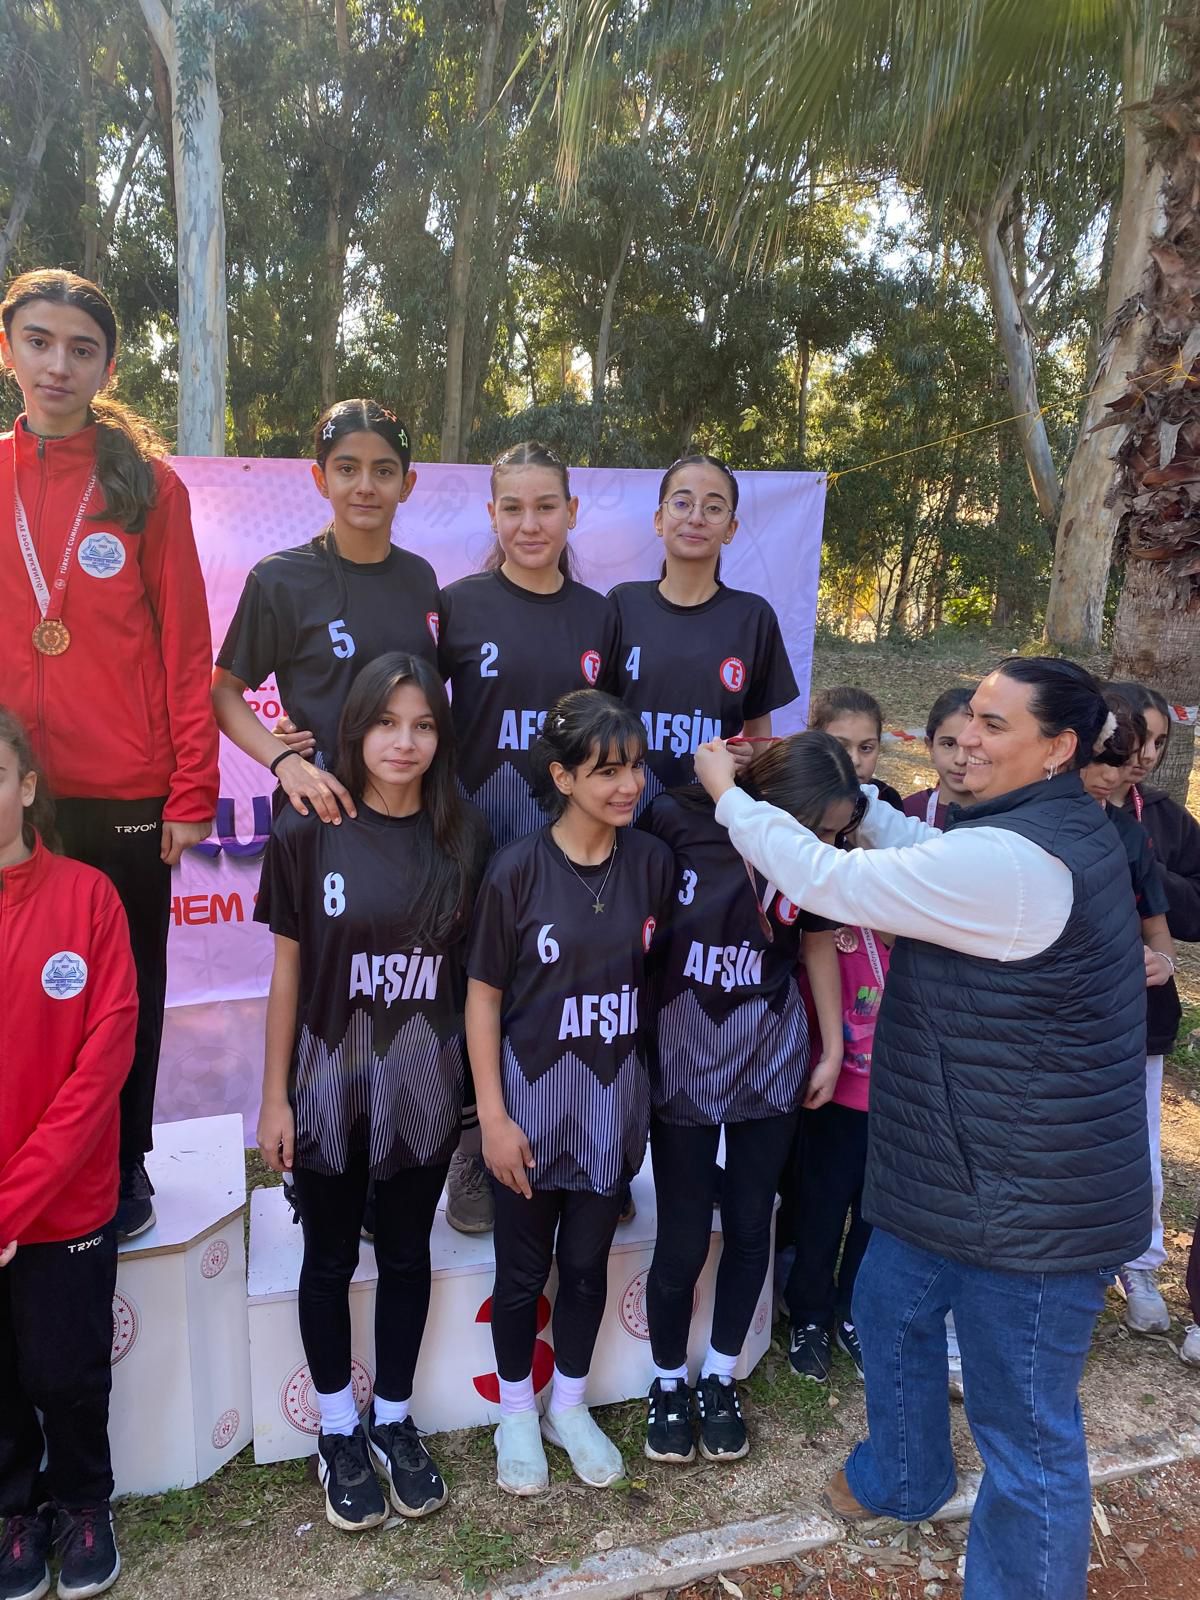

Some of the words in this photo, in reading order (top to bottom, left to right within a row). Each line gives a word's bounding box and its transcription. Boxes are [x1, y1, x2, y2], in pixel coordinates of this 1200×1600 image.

[60, 547, 72, 575] TÜRKİYE
[328, 619, 356, 659] 5
[480, 641, 499, 678] 2
[625, 646, 641, 680] 4
[246, 700, 288, 719] PO
[114, 821, 157, 833] TRYON
[323, 871, 346, 918] 8
[678, 869, 698, 906] 3
[537, 923, 560, 964] 6
[349, 947, 444, 1009] AFŞİN
[683, 940, 766, 993] AFŞİN
